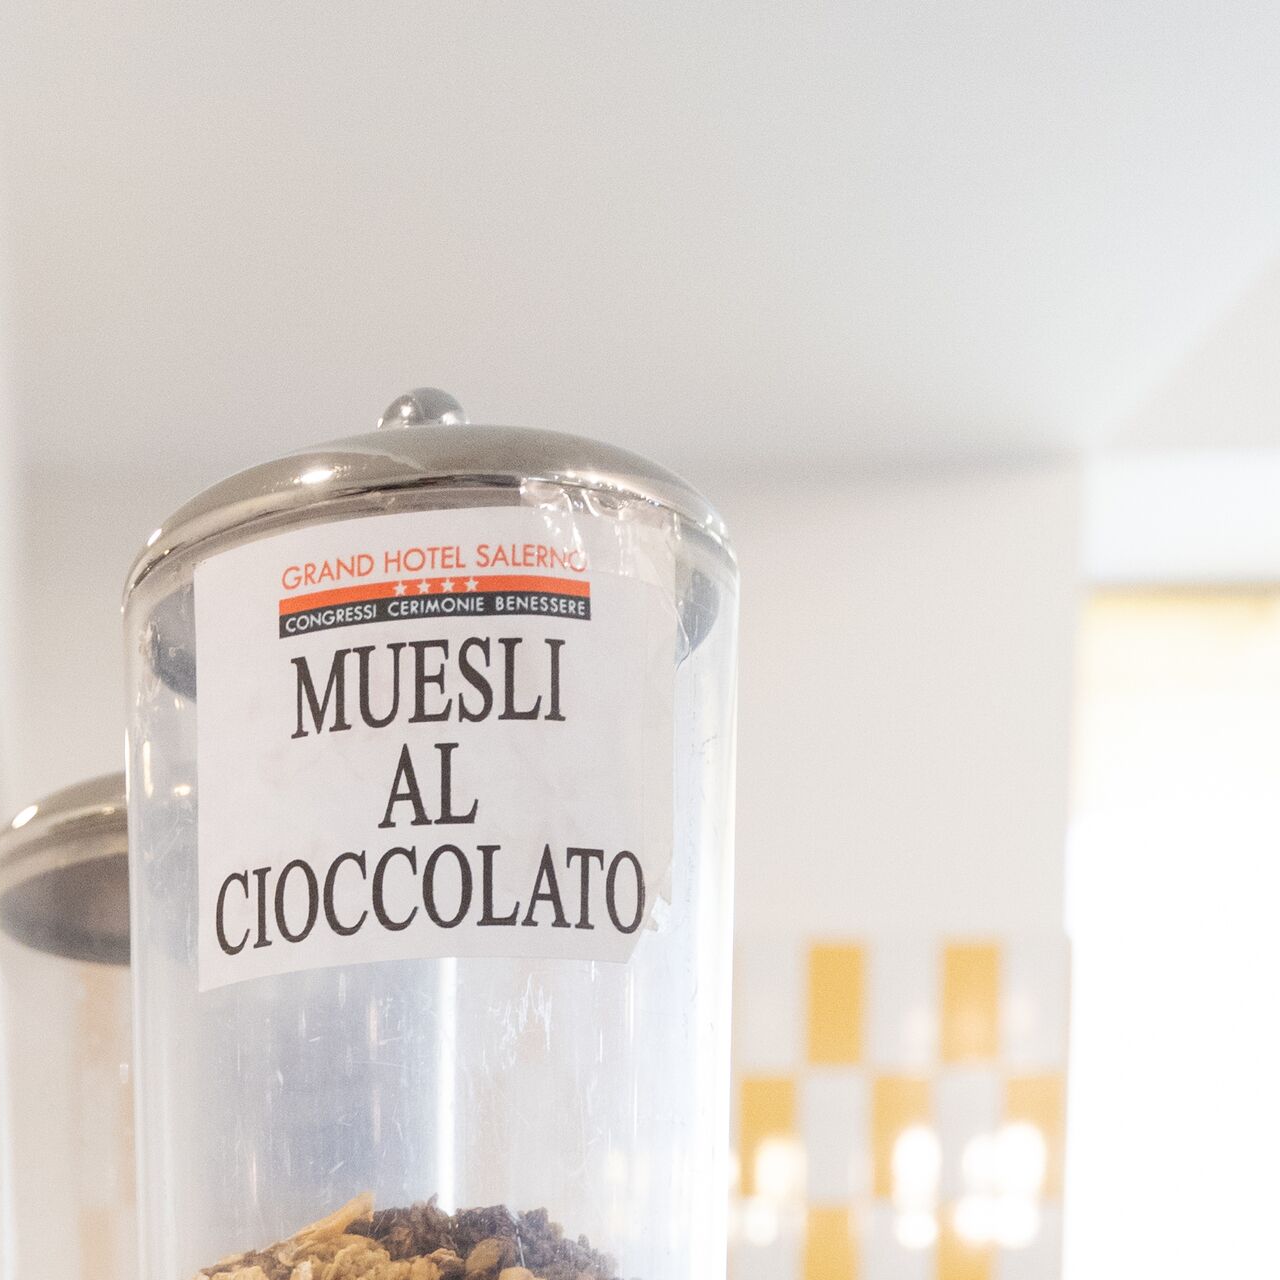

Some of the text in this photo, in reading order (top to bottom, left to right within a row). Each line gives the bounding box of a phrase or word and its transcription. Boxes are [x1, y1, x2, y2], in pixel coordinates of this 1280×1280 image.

[281, 543, 588, 590] GRAND HOTEL SALERNO
[285, 595, 586, 633] CONGRESSI CERIMONIE BENESSERE
[291, 636, 567, 740] MUESLI
[378, 742, 479, 829] AL
[215, 843, 646, 956] CIOCCOLATO
